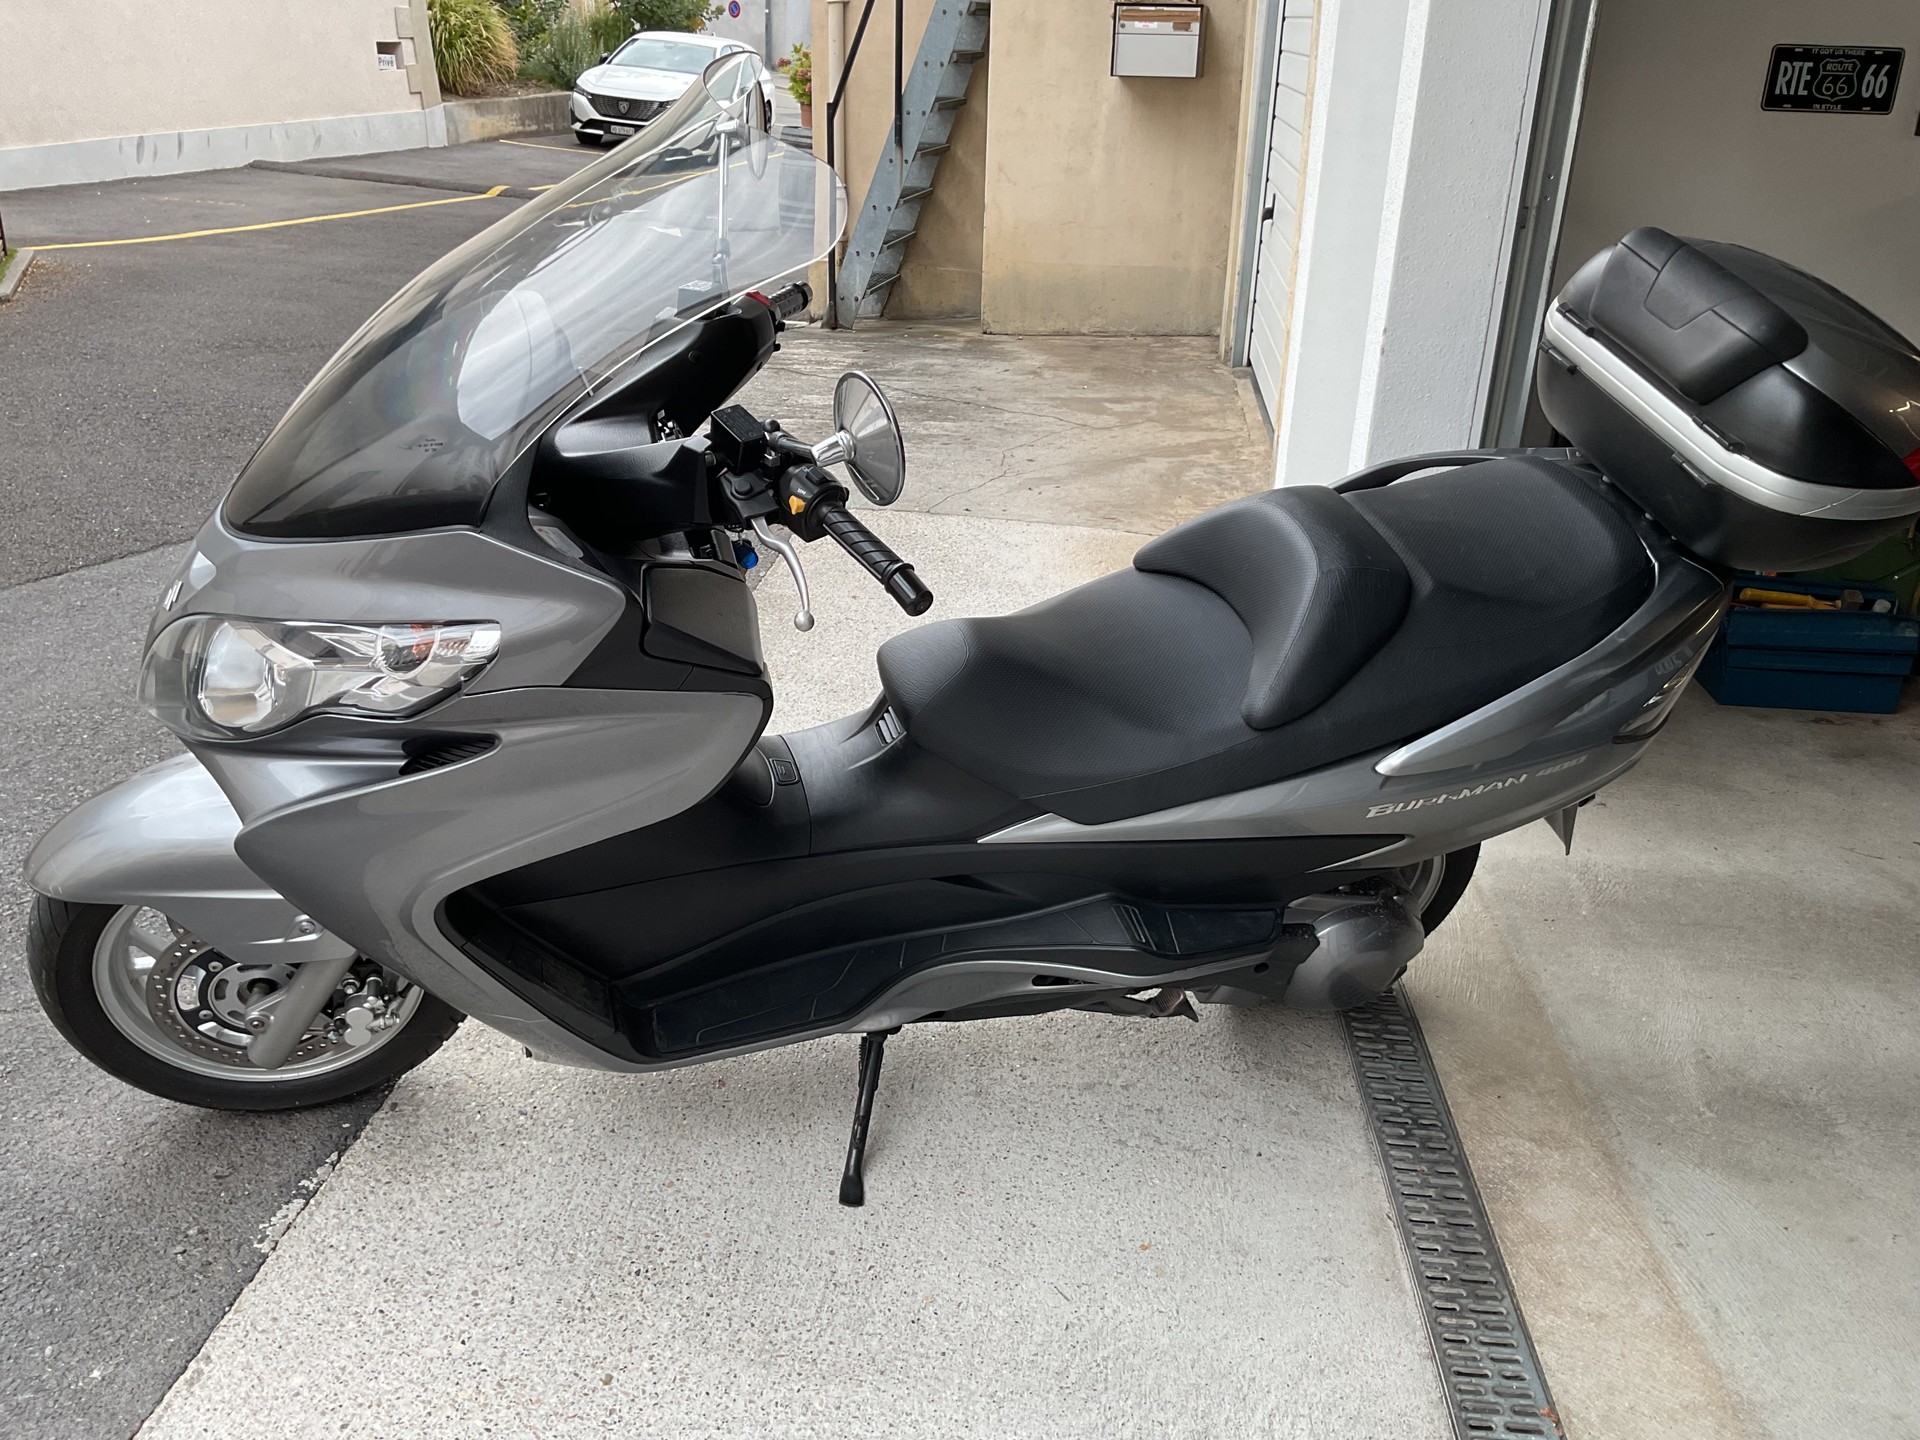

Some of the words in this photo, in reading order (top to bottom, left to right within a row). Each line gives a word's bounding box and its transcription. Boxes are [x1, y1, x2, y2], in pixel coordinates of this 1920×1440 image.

[378, 55, 394, 67] Privé
[1826, 63, 1853, 71] ROUTE
[1775, 61, 1813, 96] RTE
[1861, 64, 1891, 99] 66
[1822, 76, 1848, 95] 66
[1365, 773, 1528, 819] BURGMAN
